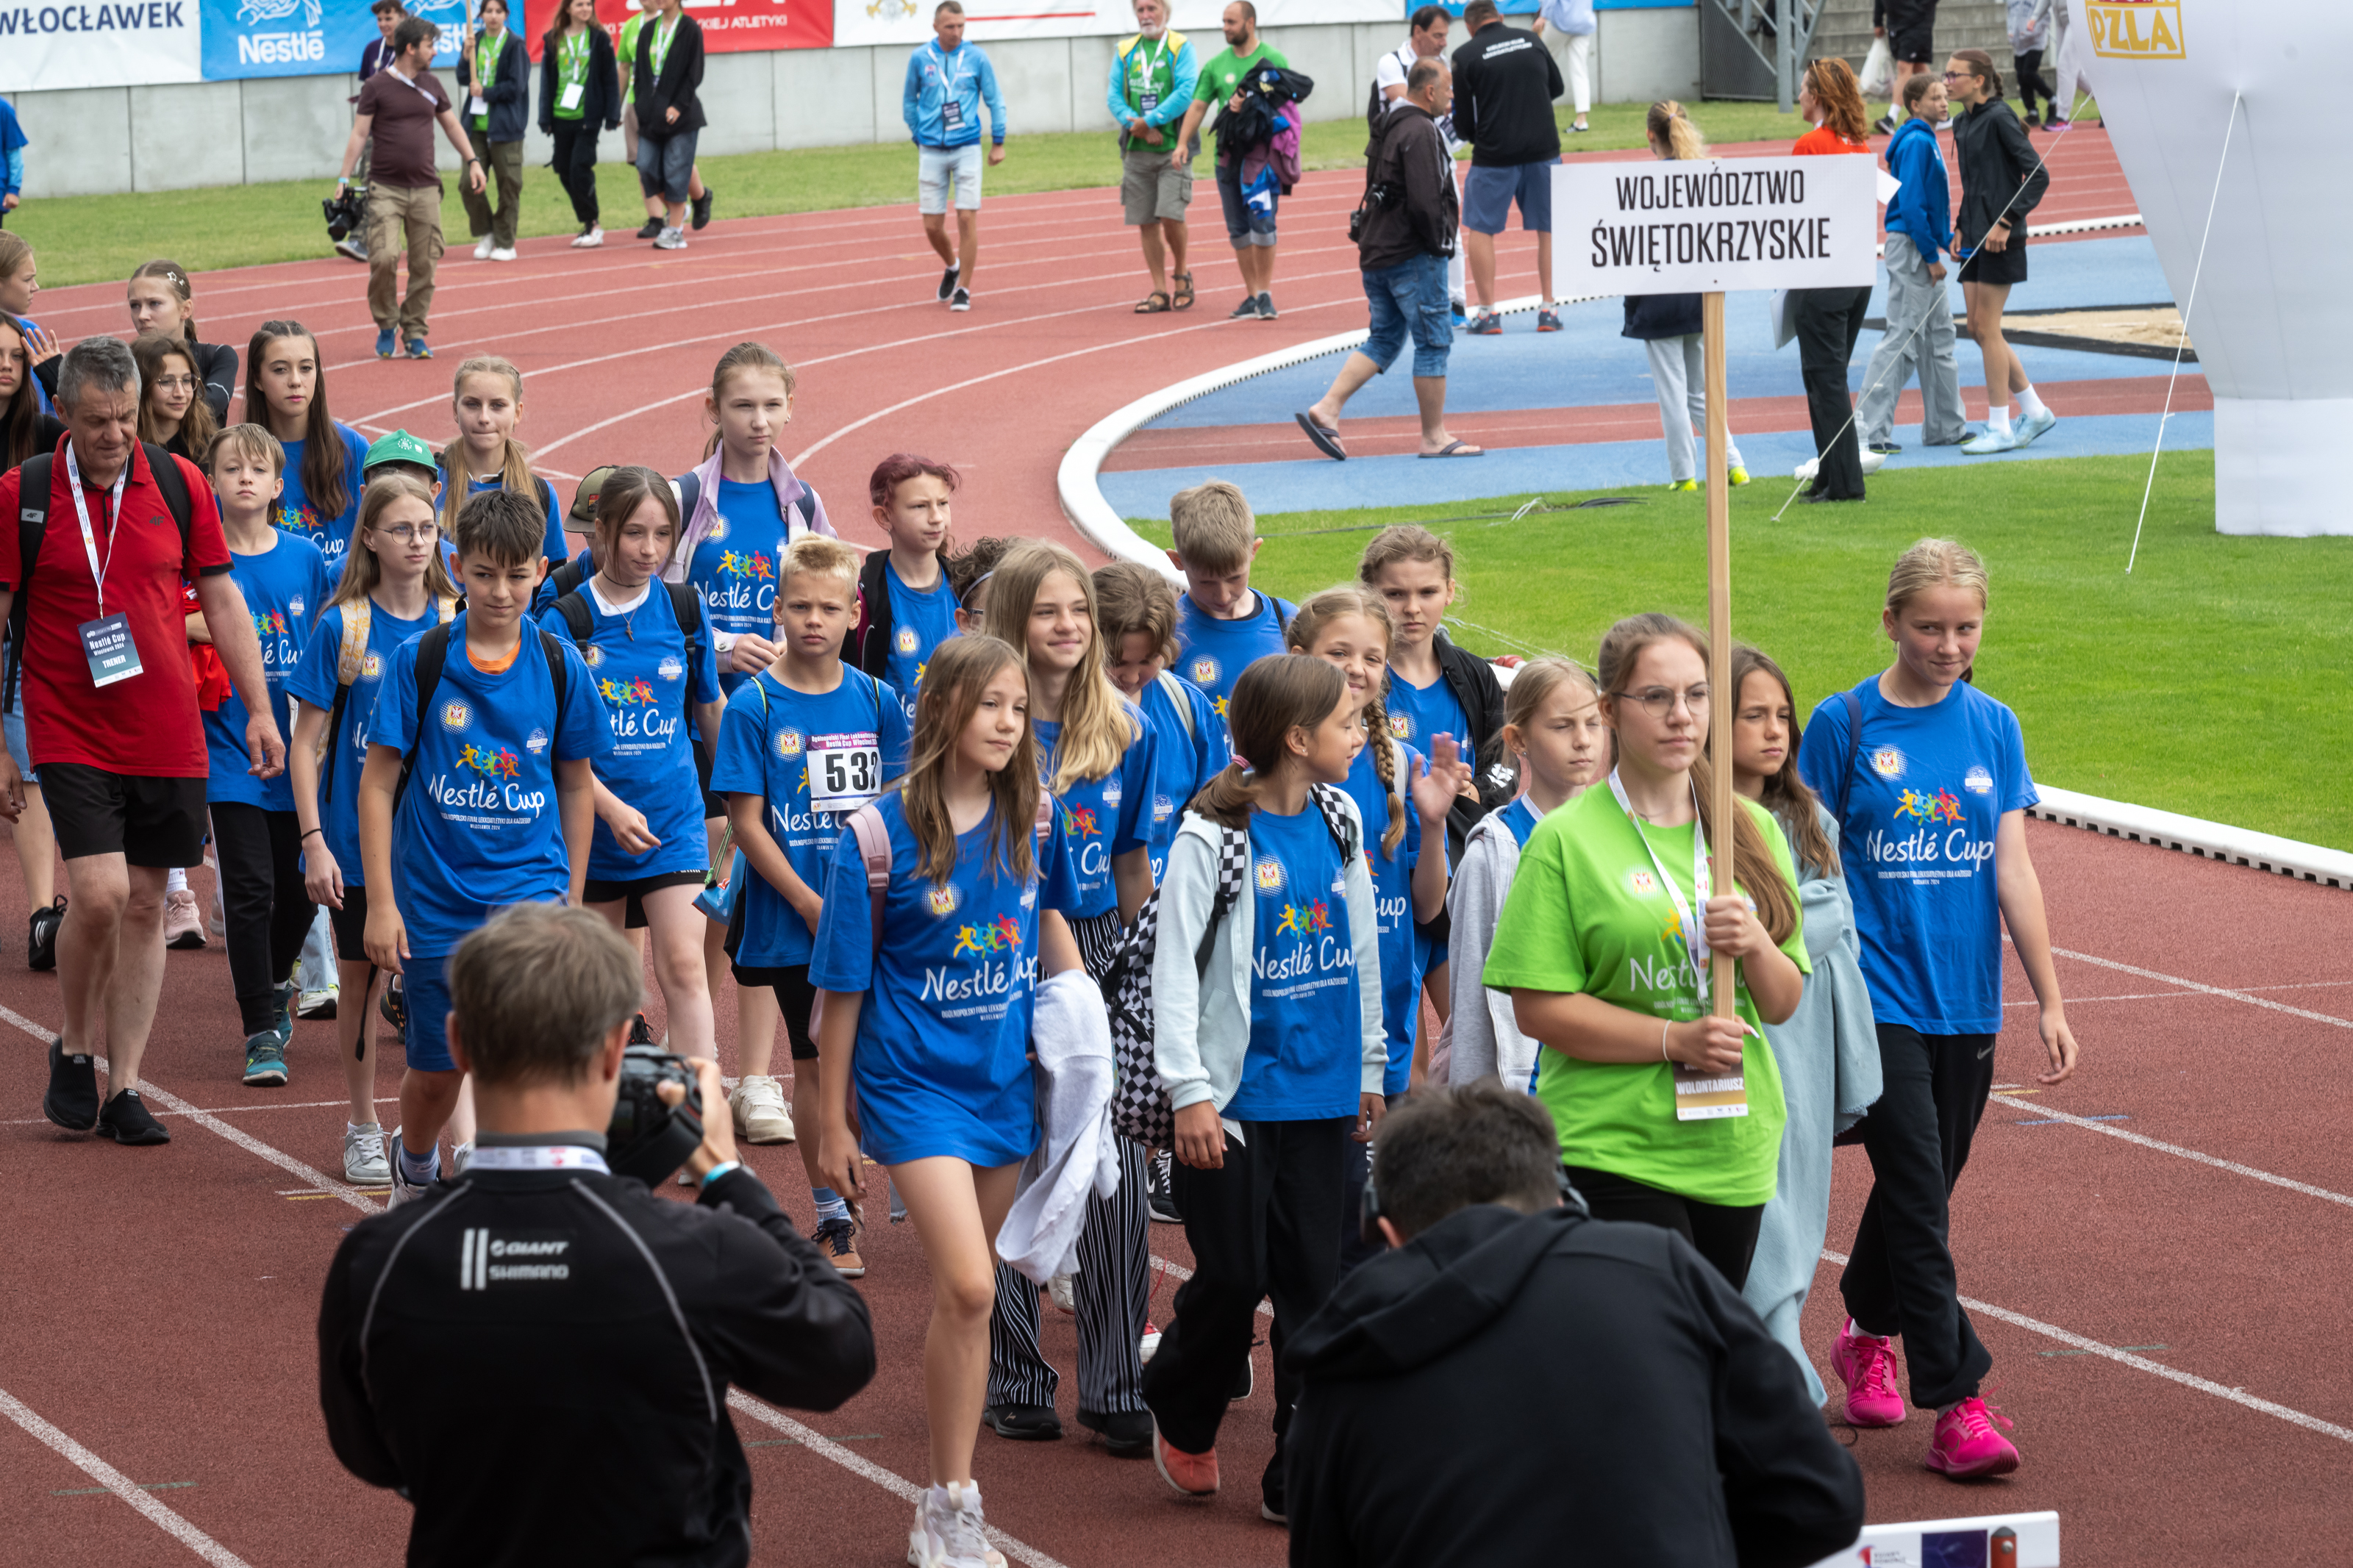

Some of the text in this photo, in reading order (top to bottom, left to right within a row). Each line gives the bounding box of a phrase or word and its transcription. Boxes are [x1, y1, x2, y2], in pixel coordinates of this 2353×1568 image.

[0, 2, 185, 35] WŁOCŁAWEK
[731, 14, 788, 29] ATLETYKI
[2089, 8, 2178, 51] PZLA
[1615, 166, 1804, 211] WOJEWÓDZTWO
[1591, 217, 1831, 272] ŚWIĘTOKRZYSKIE
[149, 515, 165, 526] 4F
[111, 633, 126, 644] Cup
[101, 654, 126, 669] TRENER
[279, 639, 302, 665] Cu
[610, 708, 677, 744] tlé Cup
[842, 740, 851, 748] Cup
[429, 773, 545, 818] Nestlé Cup
[1867, 828, 1994, 872] Nestlé Cup
[1377, 926, 1390, 934] DEGO!
[1252, 942, 1313, 980] Nestlé
[920, 960, 1009, 1001] Nestlé
[1676, 1077, 1745, 1095] WOLONTARIUSZ
[505, 1241, 569, 1256] GIANT
[488, 1264, 569, 1280] SHIMANO
